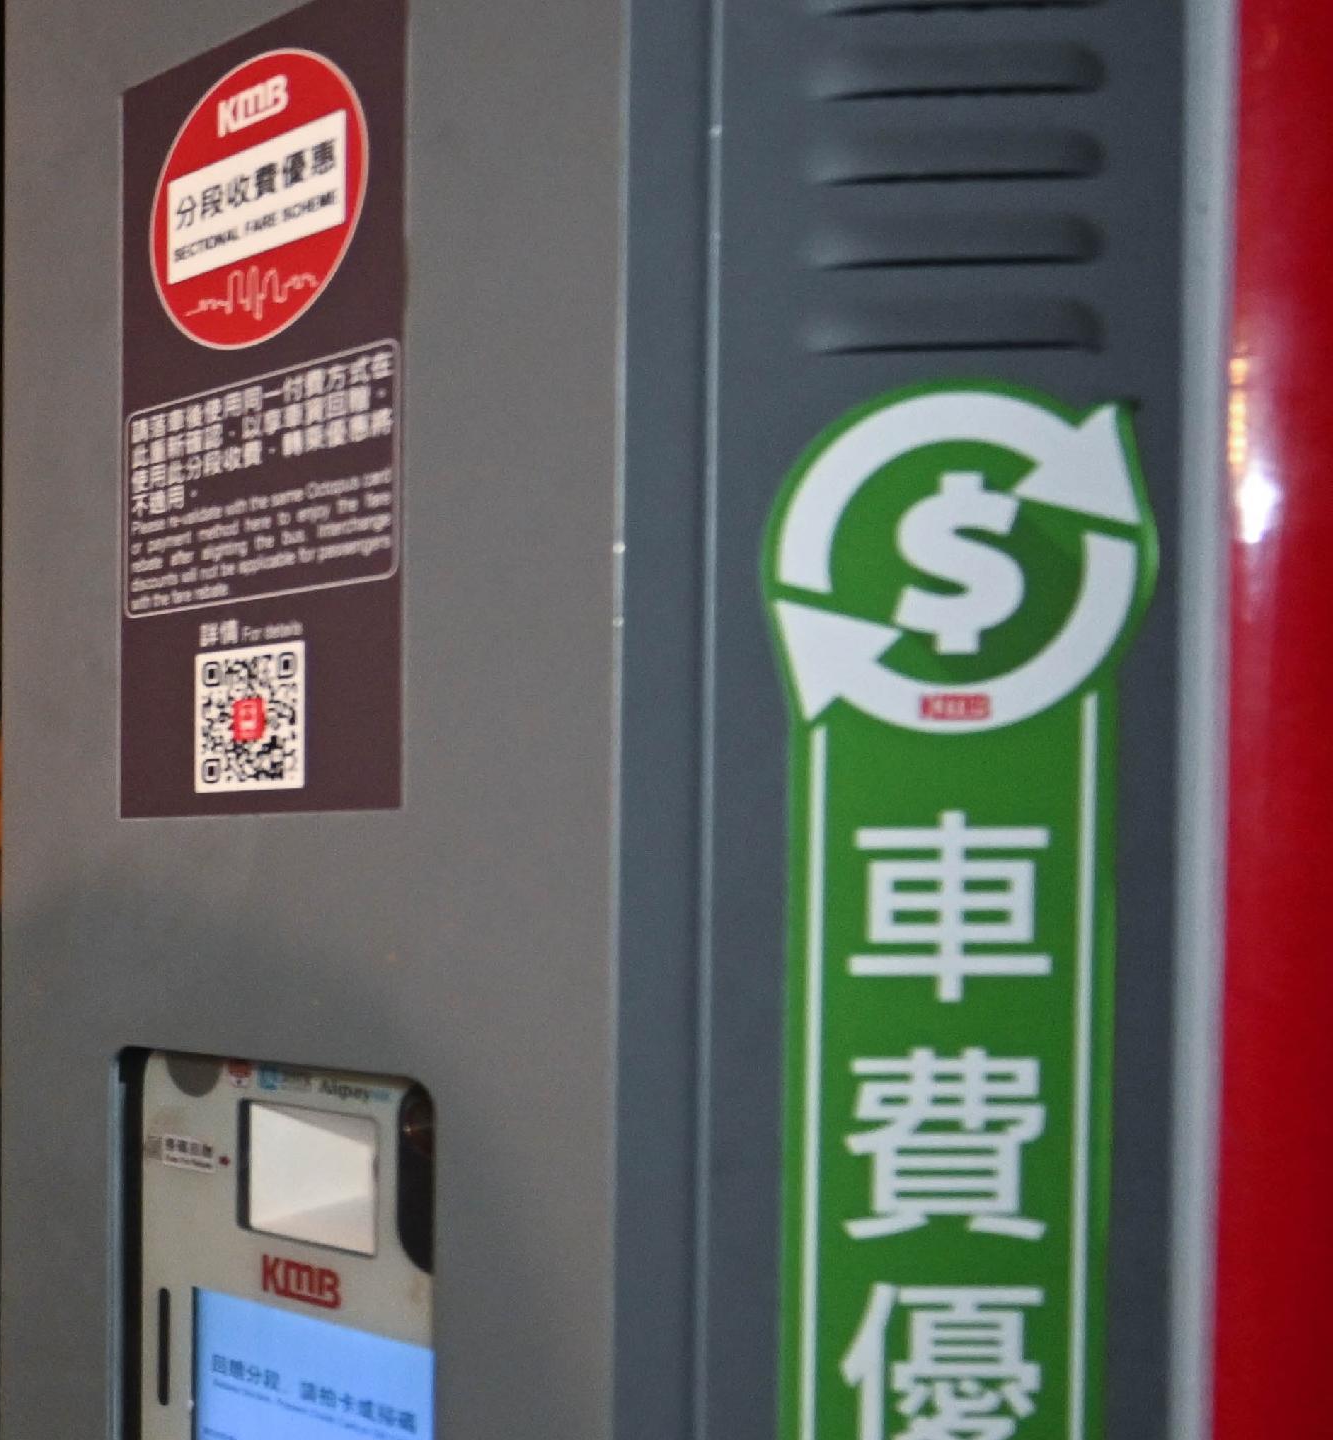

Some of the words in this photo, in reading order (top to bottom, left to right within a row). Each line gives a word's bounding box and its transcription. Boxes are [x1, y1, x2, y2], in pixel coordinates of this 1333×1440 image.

[217, 74, 289, 138] KMB
[175, 137, 336, 230] 分段收費優惠
[174, 229, 241, 262] SECTIONAL
[245, 215, 278, 238] FARE
[282, 190, 337, 222] SCHEME
[262, 1254, 341, 1309] KMB
